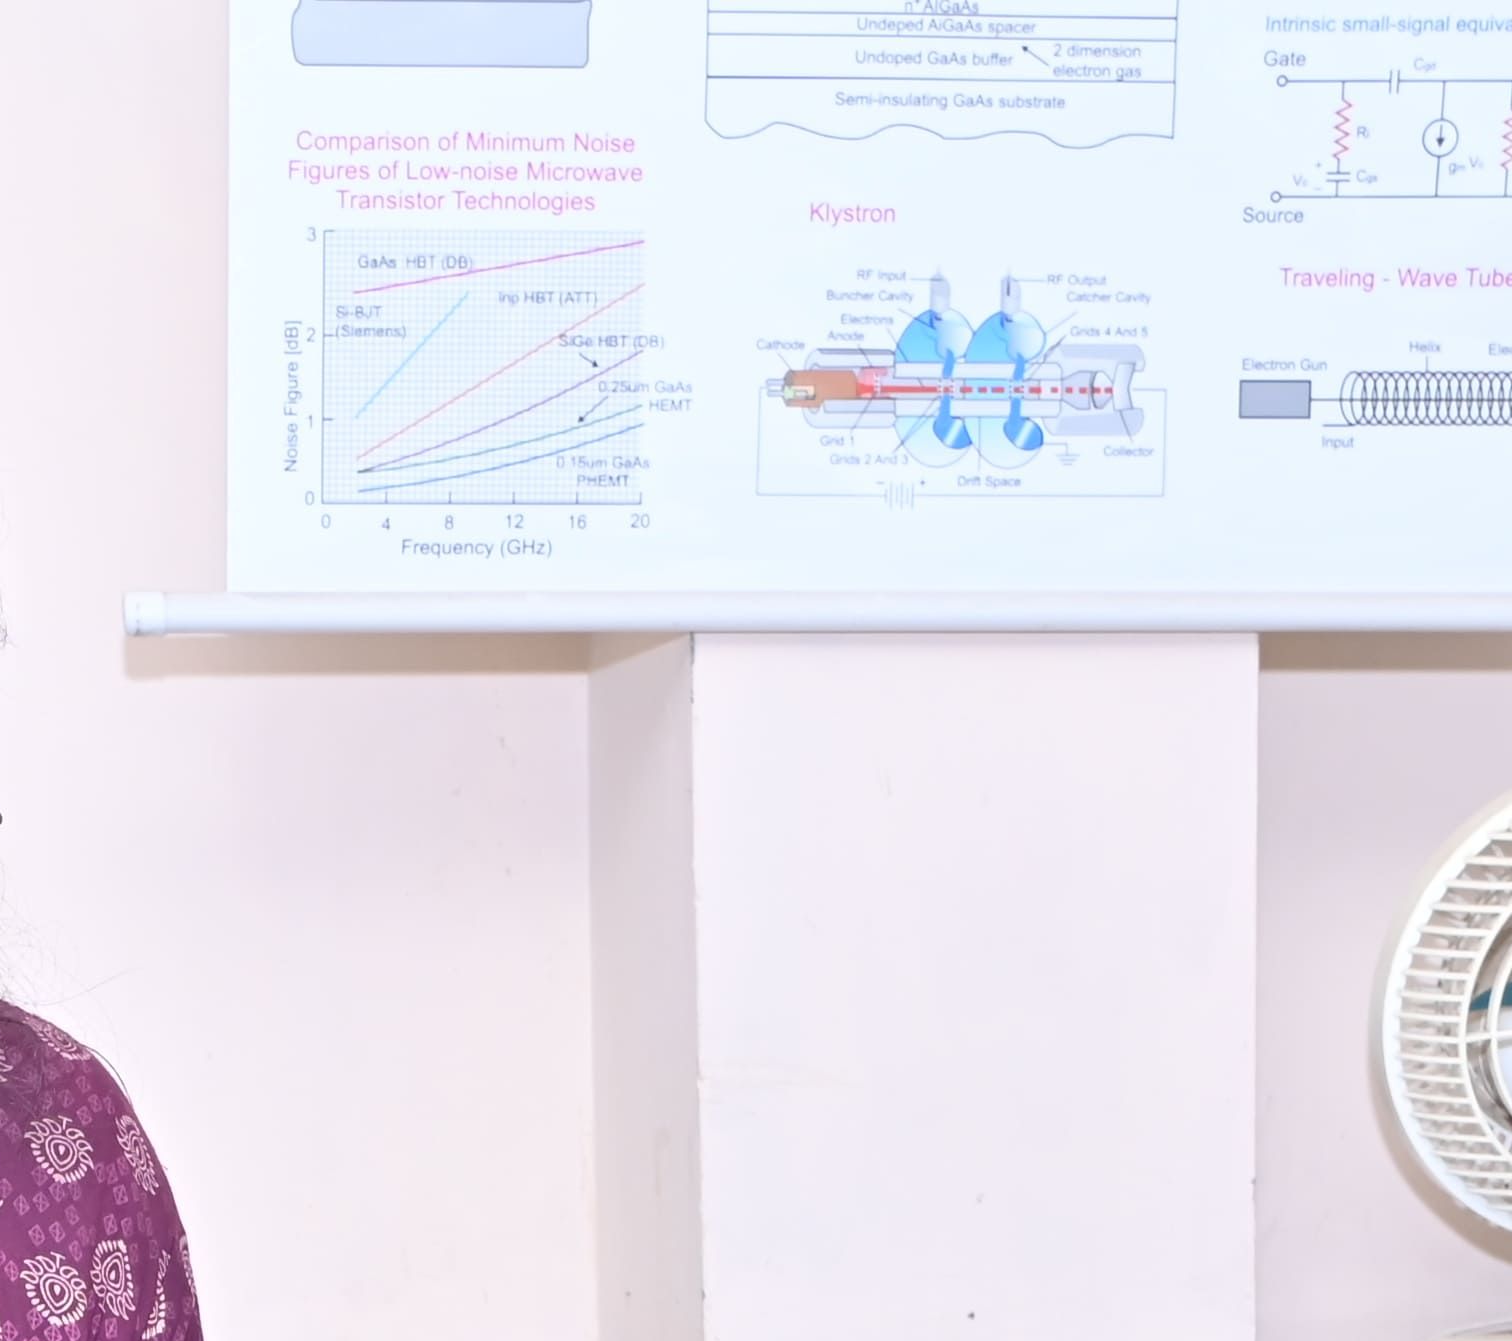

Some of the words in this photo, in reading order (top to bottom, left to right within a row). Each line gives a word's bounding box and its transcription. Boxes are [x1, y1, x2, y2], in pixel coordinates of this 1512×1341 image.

[988, 20, 1036, 37] spacer
[1266, 16, 1336, 33] Intrinsic
[1343, 16, 1450, 36] small-signal
[1054, 44, 1061, 58] 2
[1067, 44, 1140, 58] dimension
[855, 50, 922, 67] Undoped
[928, 52, 966, 66] GaAs
[972, 52, 1013, 67] buffer
[1264, 51, 1306, 67] Gate
[1053, 64, 1111, 78] electron
[1117, 67, 1141, 81] gas
[835, 93, 947, 110] Semi-insulating
[953, 94, 993, 108] GaAs
[999, 95, 1065, 109] substrate
[297, 131, 429, 154] Comparison
[439, 132, 459, 151] of
[466, 133, 564, 152] Minimum
[574, 134, 635, 153] Noise
[289, 161, 370, 184] Figures
[379, 162, 399, 180] of
[406, 163, 518, 181] Low-noise
[527, 163, 642, 182] Microwave
[336, 191, 445, 209] Transistor
[454, 192, 595, 215] Technologies
[810, 203, 895, 226] Klystron
[1243, 207, 1304, 224] Source
[307, 228, 317, 242] 3
[358, 256, 397, 269] GaAs
[407, 256, 436, 269] HBT
[857, 270, 874, 281] RF
[878, 270, 906, 283] Input
[1047, 274, 1062, 285] RF
[1068, 275, 1106, 287] Output
[1280, 268, 1375, 292] Traveling
[1398, 269, 1457, 288] Wave
[525, 292, 554, 303] HBT
[559, 292, 598, 306] (ATT)
[827, 290, 873, 301] Buncher
[878, 290, 914, 303] Cavity
[1067, 292, 1110, 303] Catcher
[1116, 292, 1150, 304] Cavity
[841, 314, 893, 325] Electrons
[307, 329, 316, 342] 2
[335, 325, 407, 339] (Siemens)
[828, 330, 864, 341] Anode
[1070, 327, 1099, 337] Grids
[1114, 326, 1136, 337] And
[284, 320, 303, 360] [dB]
[598, 335, 630, 347] HBT
[756, 339, 804, 350] Cathode
[1409, 341, 1441, 353] Helix
[1242, 359, 1295, 371] Electron
[1301, 360, 1327, 372] Gun
[283, 361, 303, 417] Figure
[654, 381, 692, 393] GaAs
[650, 400, 692, 411] HEMT
[283, 421, 298, 473] Noise
[1322, 436, 1354, 450] Input
[1103, 445, 1154, 457] Collector
[613, 458, 649, 469] GaAs
[874, 454, 896, 465] And
[985, 476, 1021, 489] Space
[305, 492, 315, 505] 0
[322, 515, 330, 528] 0
[382, 516, 390, 530] 4
[444, 516, 454, 529] 8
[507, 516, 524, 529] 12
[570, 516, 586, 529] 16
[631, 514, 649, 528] 20
[402, 539, 494, 558] Frequency
[500, 539, 552, 557] (GHz)
